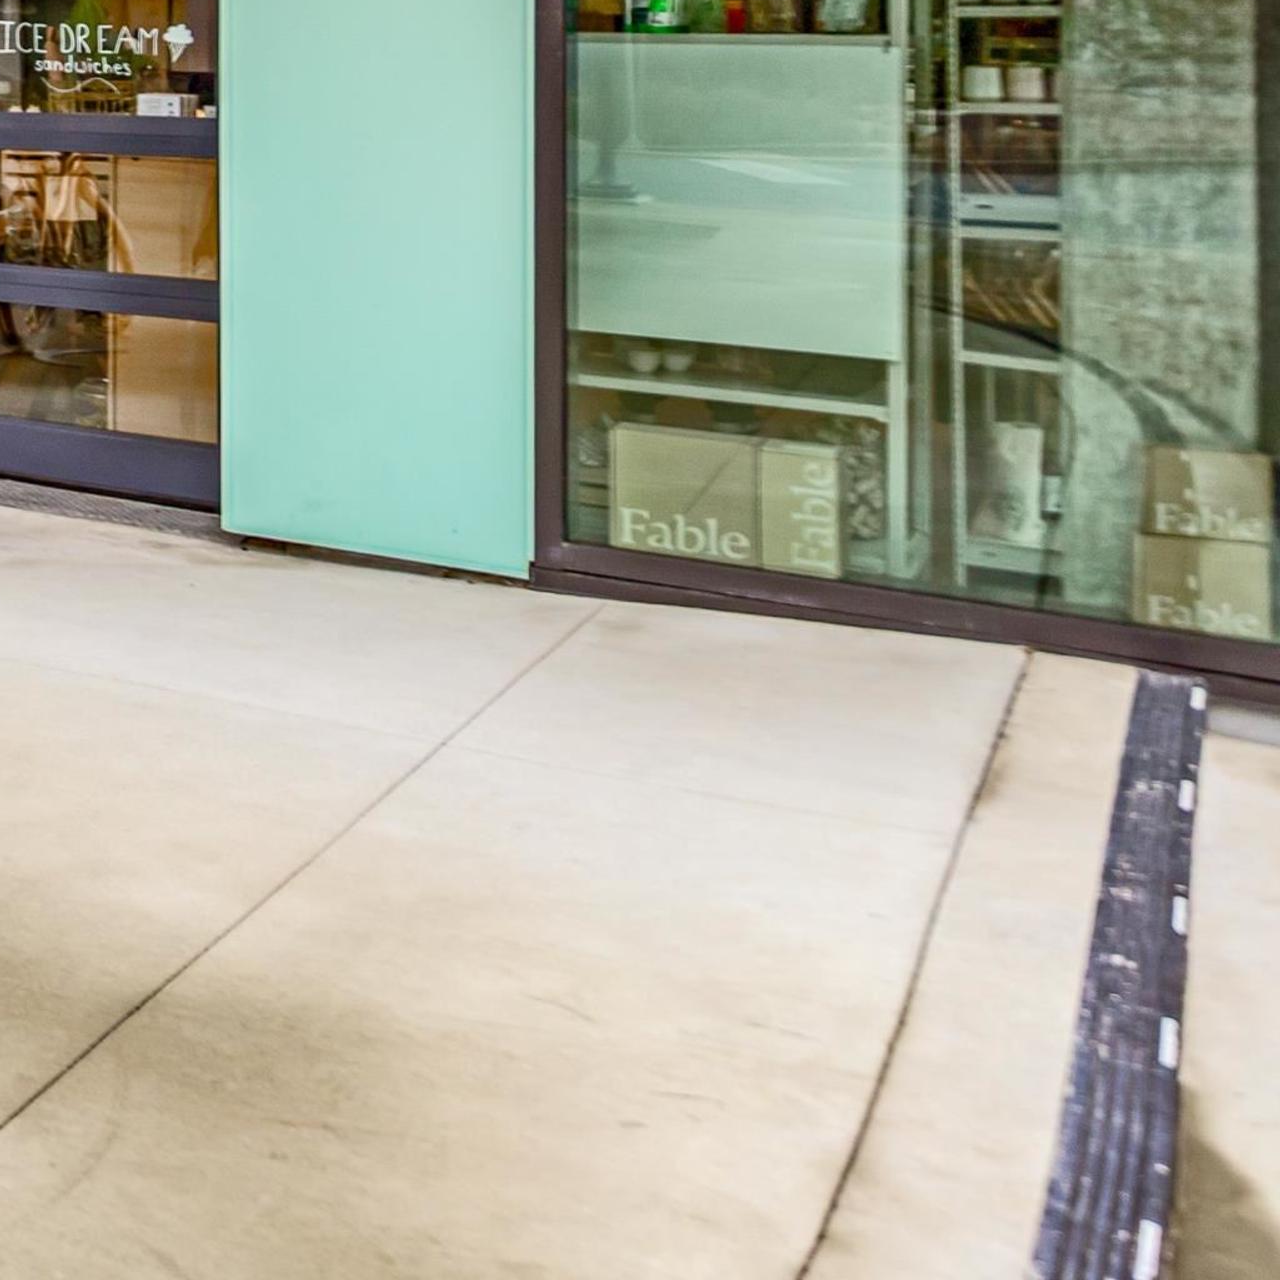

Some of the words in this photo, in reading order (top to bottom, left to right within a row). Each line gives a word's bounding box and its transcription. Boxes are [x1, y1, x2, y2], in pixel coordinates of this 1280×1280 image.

[59, 23, 159, 57] DREAM
[34, 55, 132, 76] sandwiches
[618, 506, 752, 559] Fable
[787, 461, 836, 574] Fable
